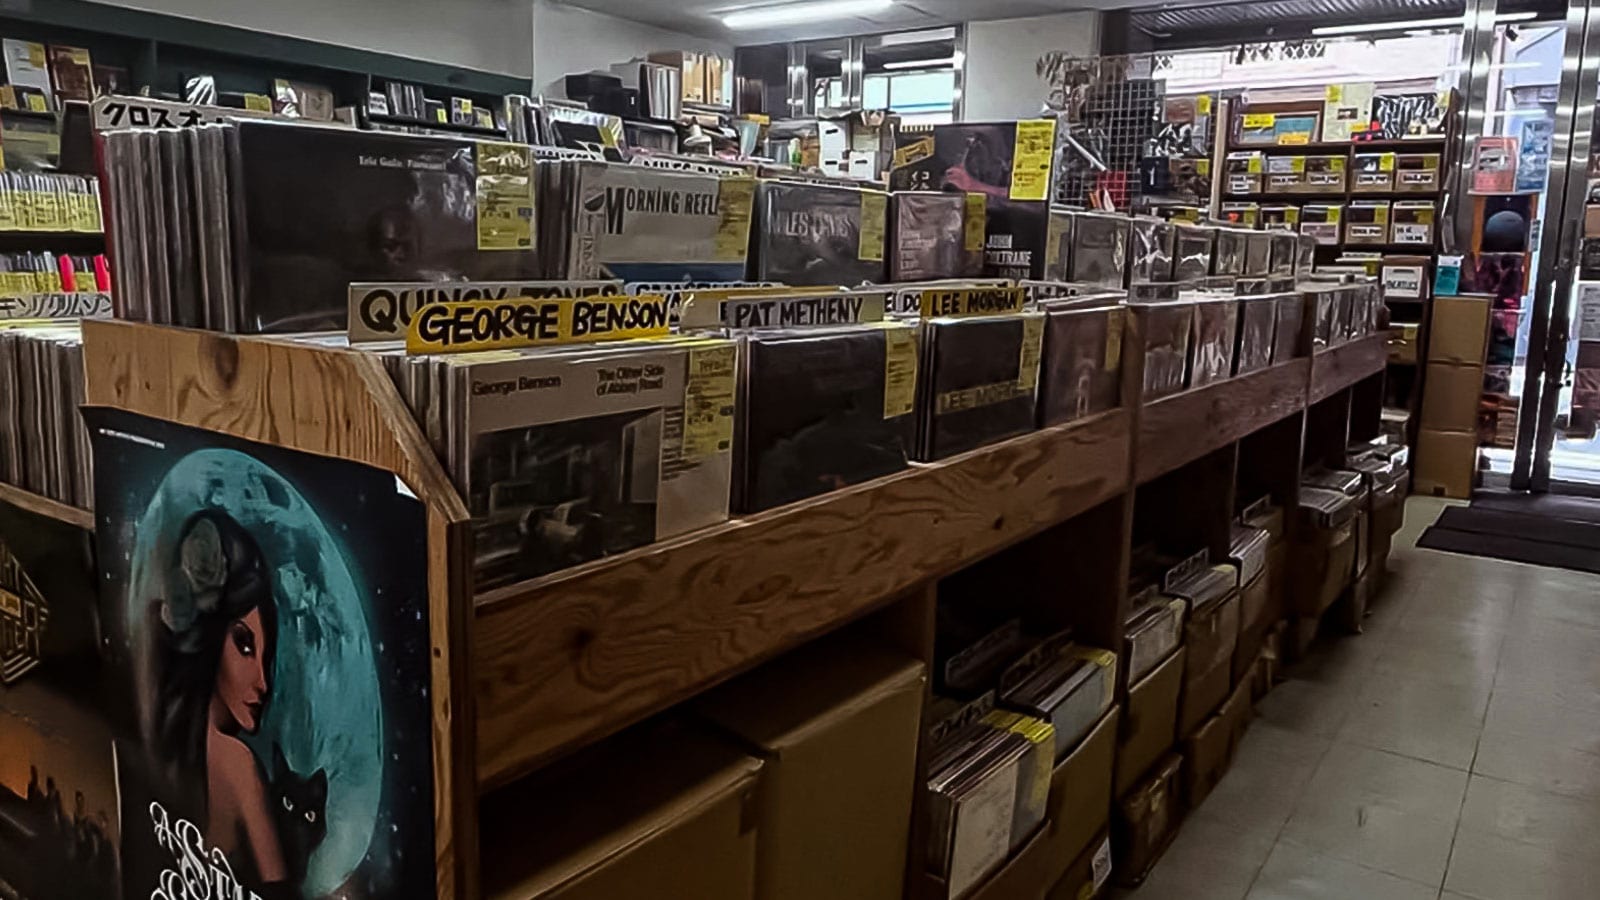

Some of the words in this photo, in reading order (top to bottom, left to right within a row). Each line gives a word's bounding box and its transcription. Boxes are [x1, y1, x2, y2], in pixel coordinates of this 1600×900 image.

[606, 186, 679, 234] MORNING
[685, 193, 718, 215] REFL
[735, 300, 773, 328] PAT
[779, 297, 864, 326] METHENY
[931, 292, 961, 315] LEE
[966, 290, 1018, 312] MORGAN
[417, 303, 560, 345] GEORGE
[571, 297, 670, 337] BENSON
[471, 378, 517, 397] George
[518, 375, 562, 391] Benson
